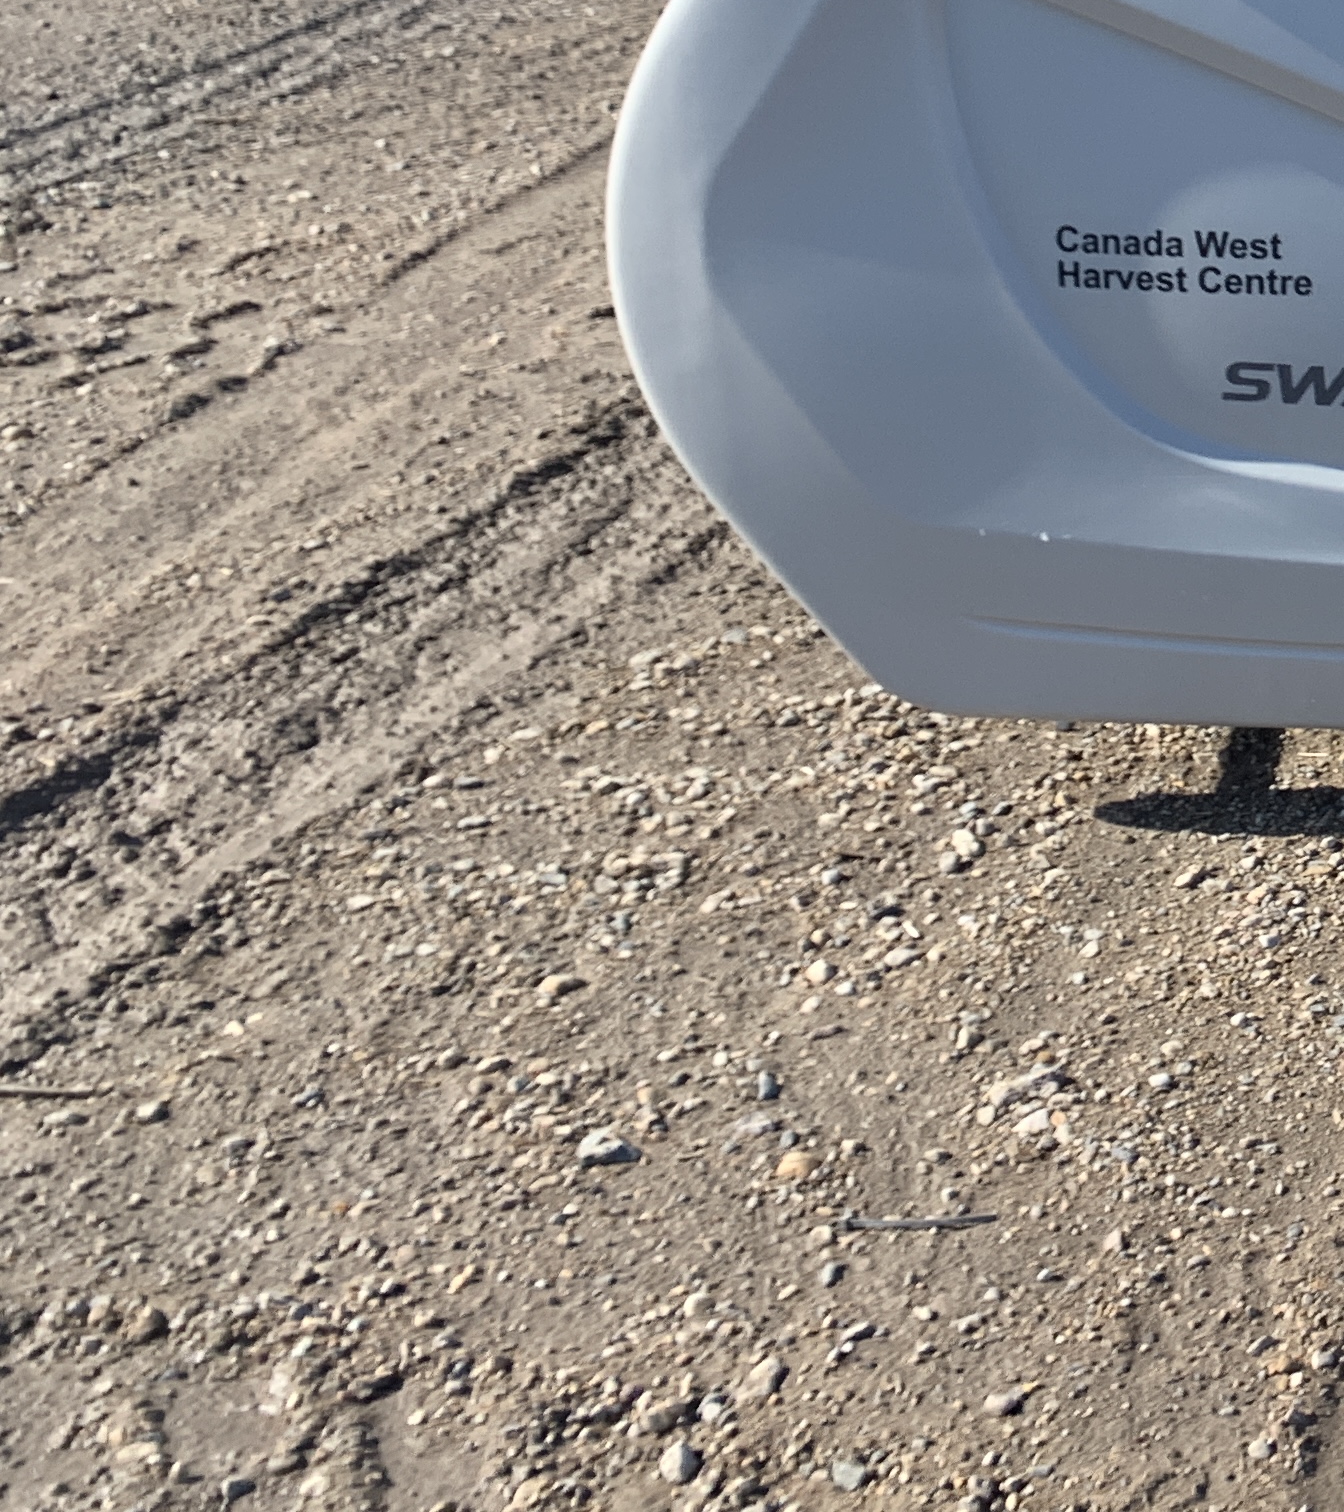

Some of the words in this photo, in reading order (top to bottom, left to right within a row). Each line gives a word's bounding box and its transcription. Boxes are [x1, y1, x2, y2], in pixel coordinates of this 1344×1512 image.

[1055, 224, 1184, 257] Canada
[1194, 230, 1283, 260] West
[1057, 259, 1189, 293] Harvest
[1198, 266, 1313, 296] Centre
